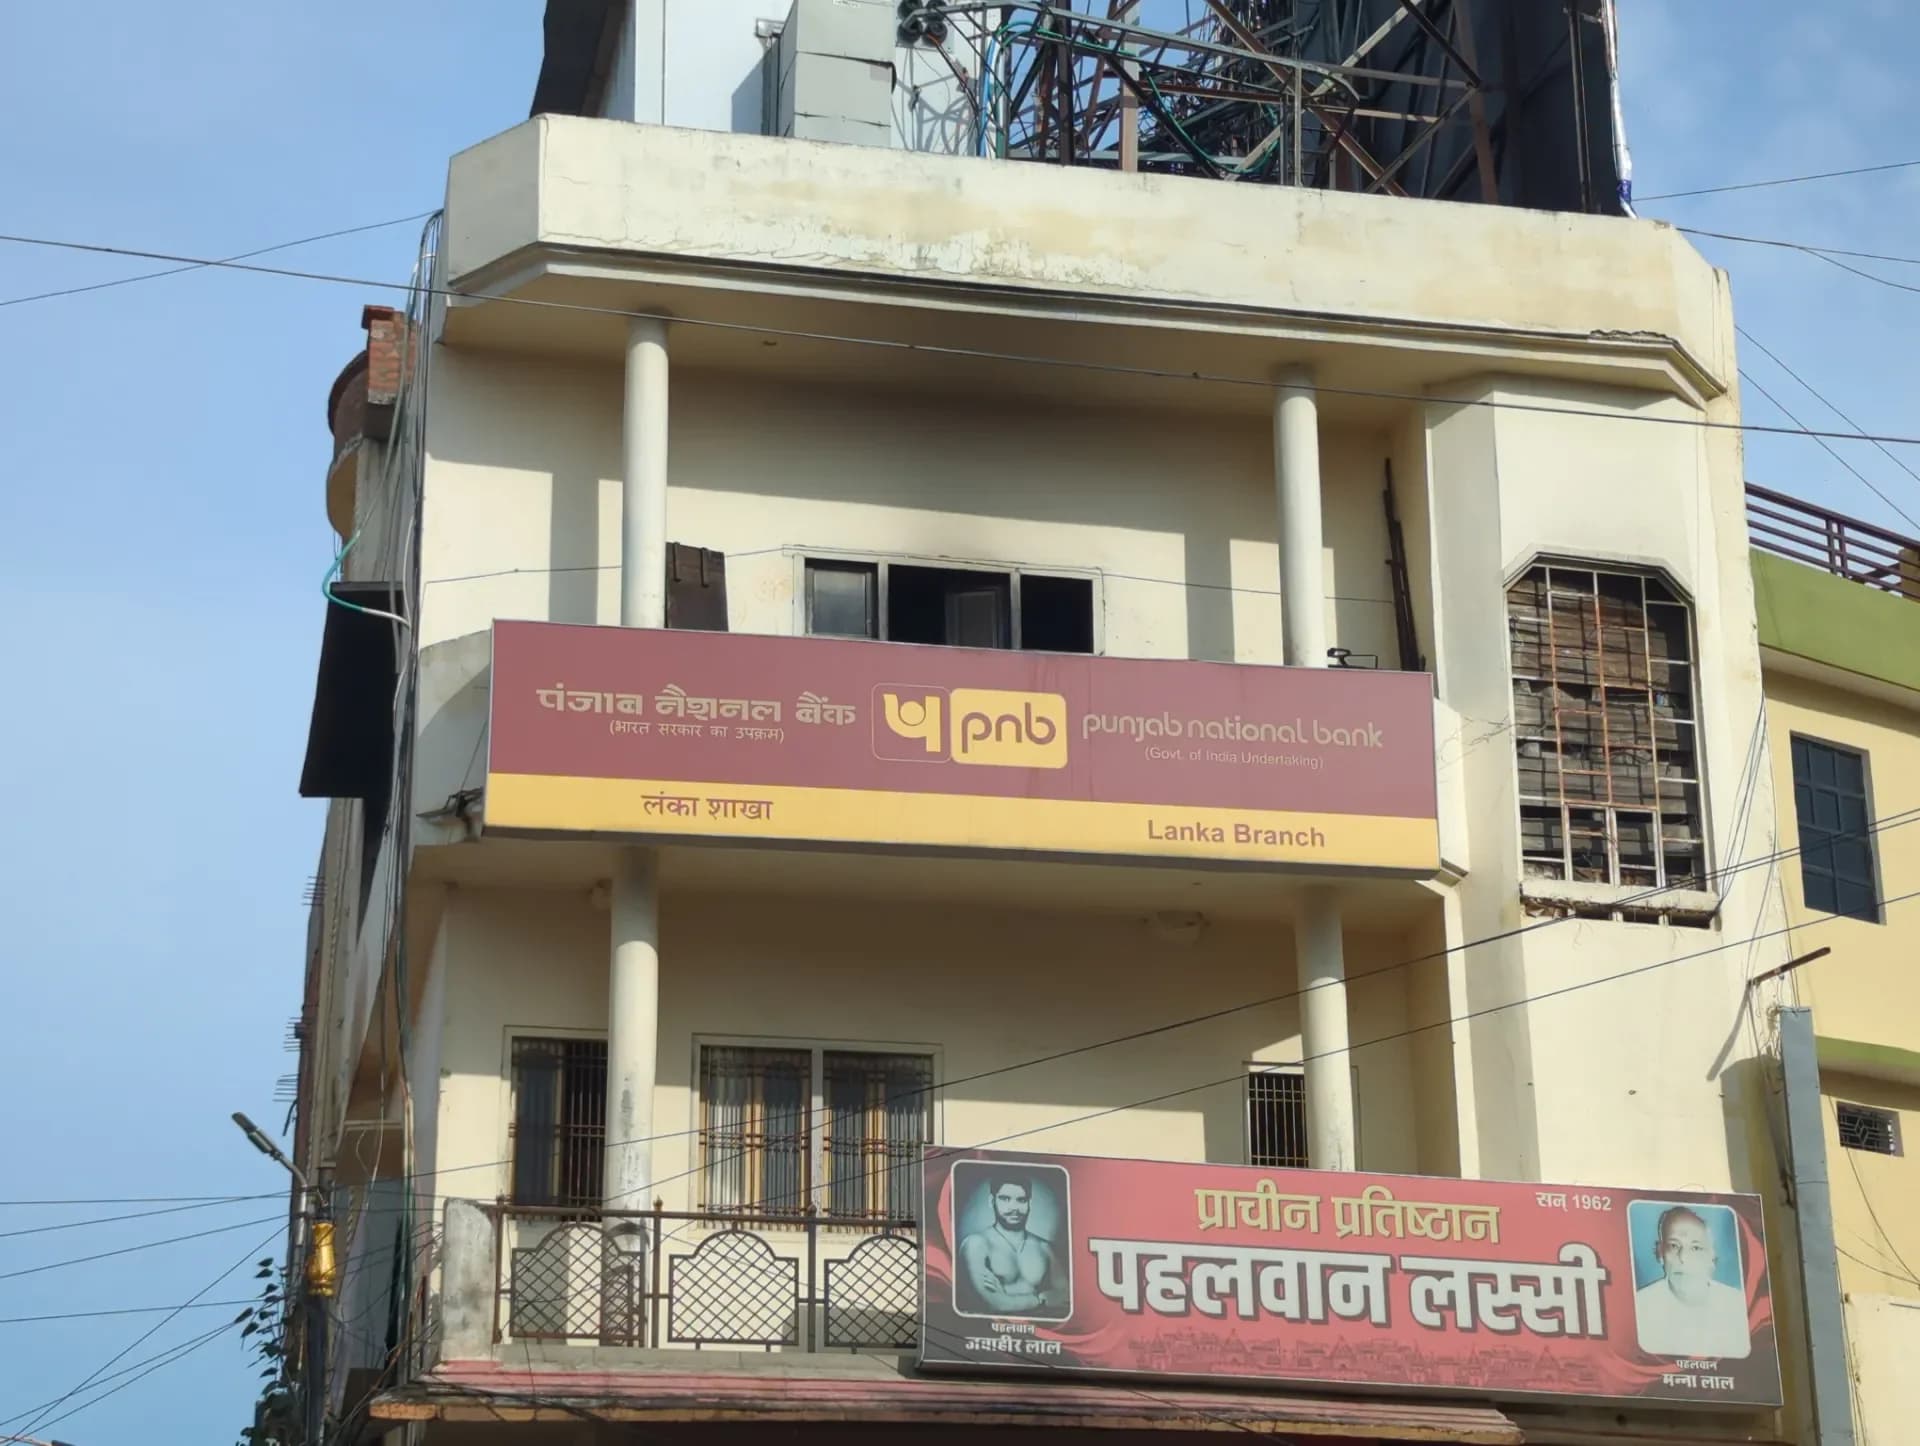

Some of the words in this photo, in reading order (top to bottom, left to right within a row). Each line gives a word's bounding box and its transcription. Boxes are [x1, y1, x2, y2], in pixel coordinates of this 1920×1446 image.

[536, 683, 643, 715] पंजाब
[655, 684, 781, 722] नैशनल
[796, 691, 856, 725] बैंक
[609, 720, 650, 736] (भारत
[658, 723, 703, 737] सरकार
[710, 725, 728, 738] का
[961, 702, 1056, 753] pnb
[1083, 712, 1182, 742] punjab
[1188, 716, 1308, 745] national
[1313, 720, 1383, 748] bank
[1189, 749, 1202, 761] of
[1206, 750, 1237, 763] India
[1242, 752, 1323, 769] Undertaking)
[641, 791, 700, 817] लंका
[706, 798, 773, 819] शाखा
[1148, 820, 1224, 843] Lanka
[1234, 824, 1325, 847] Branch
[1194, 1179, 1321, 1232] प्राचीन
[1331, 1185, 1500, 1243] प्रतिष्ठान
[1572, 1195, 1612, 1211] 1962
[1089, 1239, 1392, 1324] पहलवान
[1400, 1243, 1606, 1336] लस्सी
[1025, 1339, 1061, 1355] लाल
[1700, 1375, 1734, 1390] लाल
